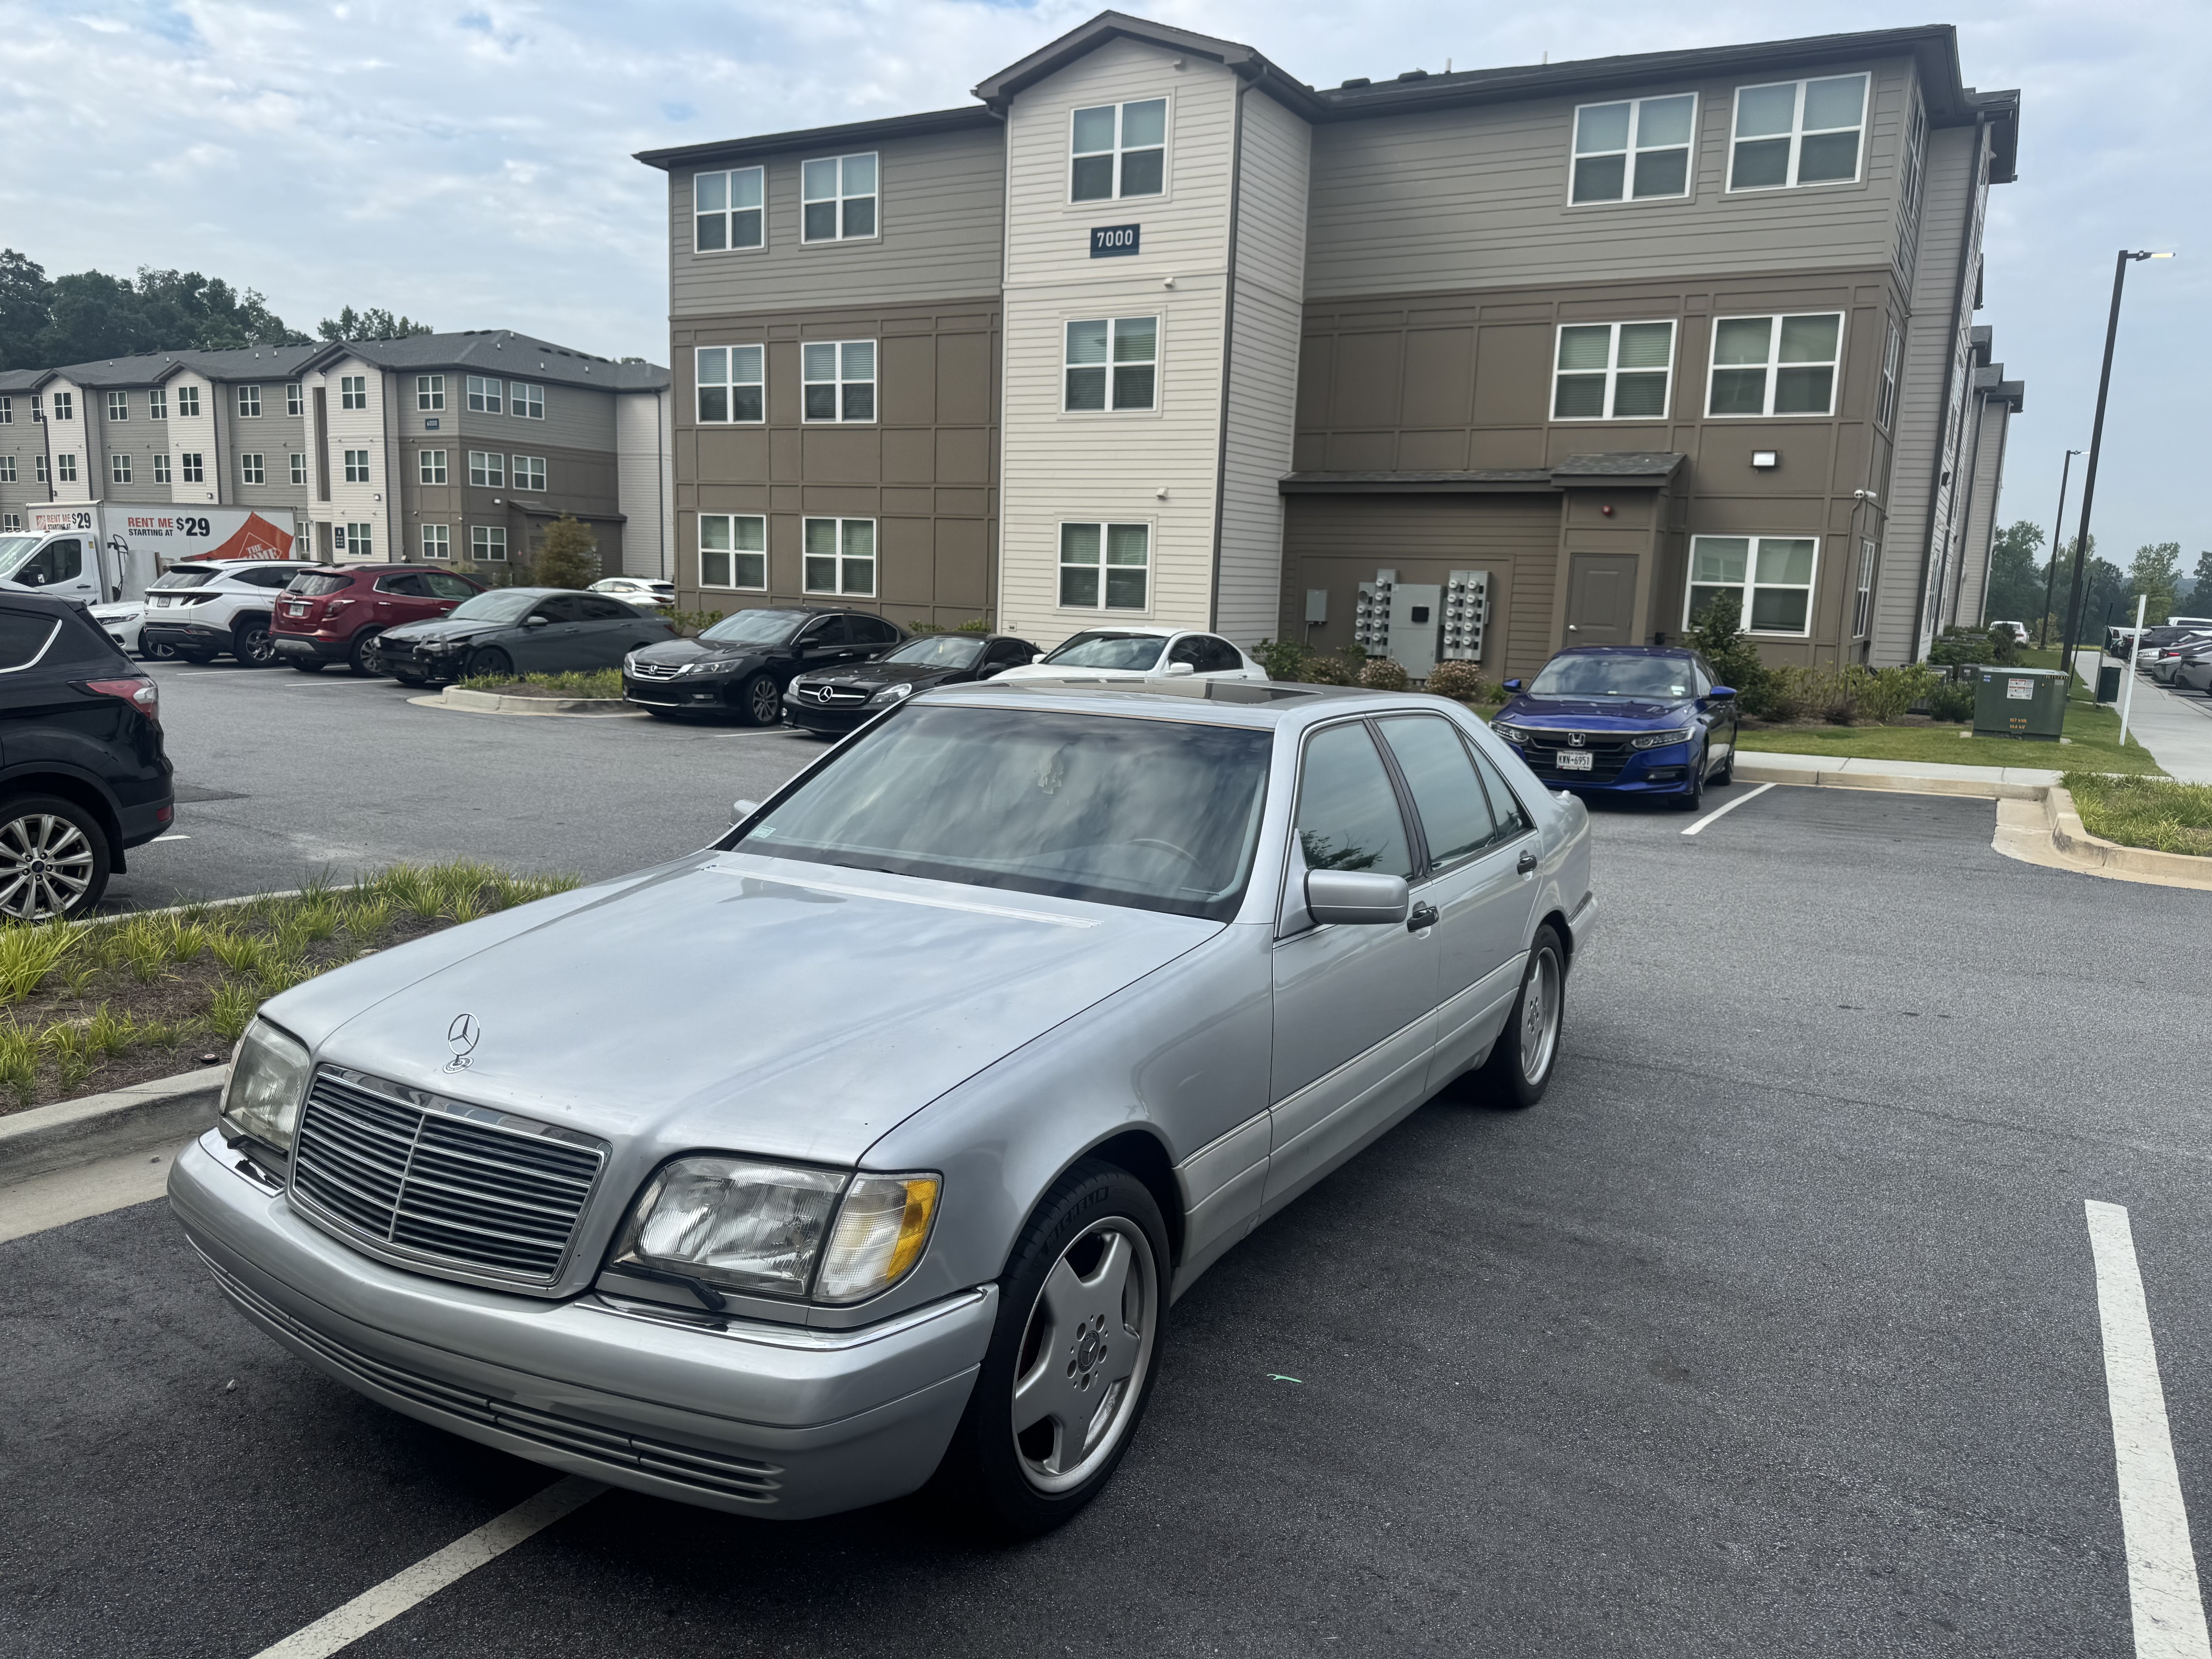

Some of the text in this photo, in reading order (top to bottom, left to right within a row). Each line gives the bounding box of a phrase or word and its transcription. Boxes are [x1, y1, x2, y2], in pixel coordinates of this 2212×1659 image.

[1097, 229, 1133, 247] 7000
[46, 513, 91, 529] RENT ME $29
[128, 517, 210, 537] RENT ME $29
[246, 543, 263, 554] THE
[1046, 1187, 1106, 1250] MICHELIN
